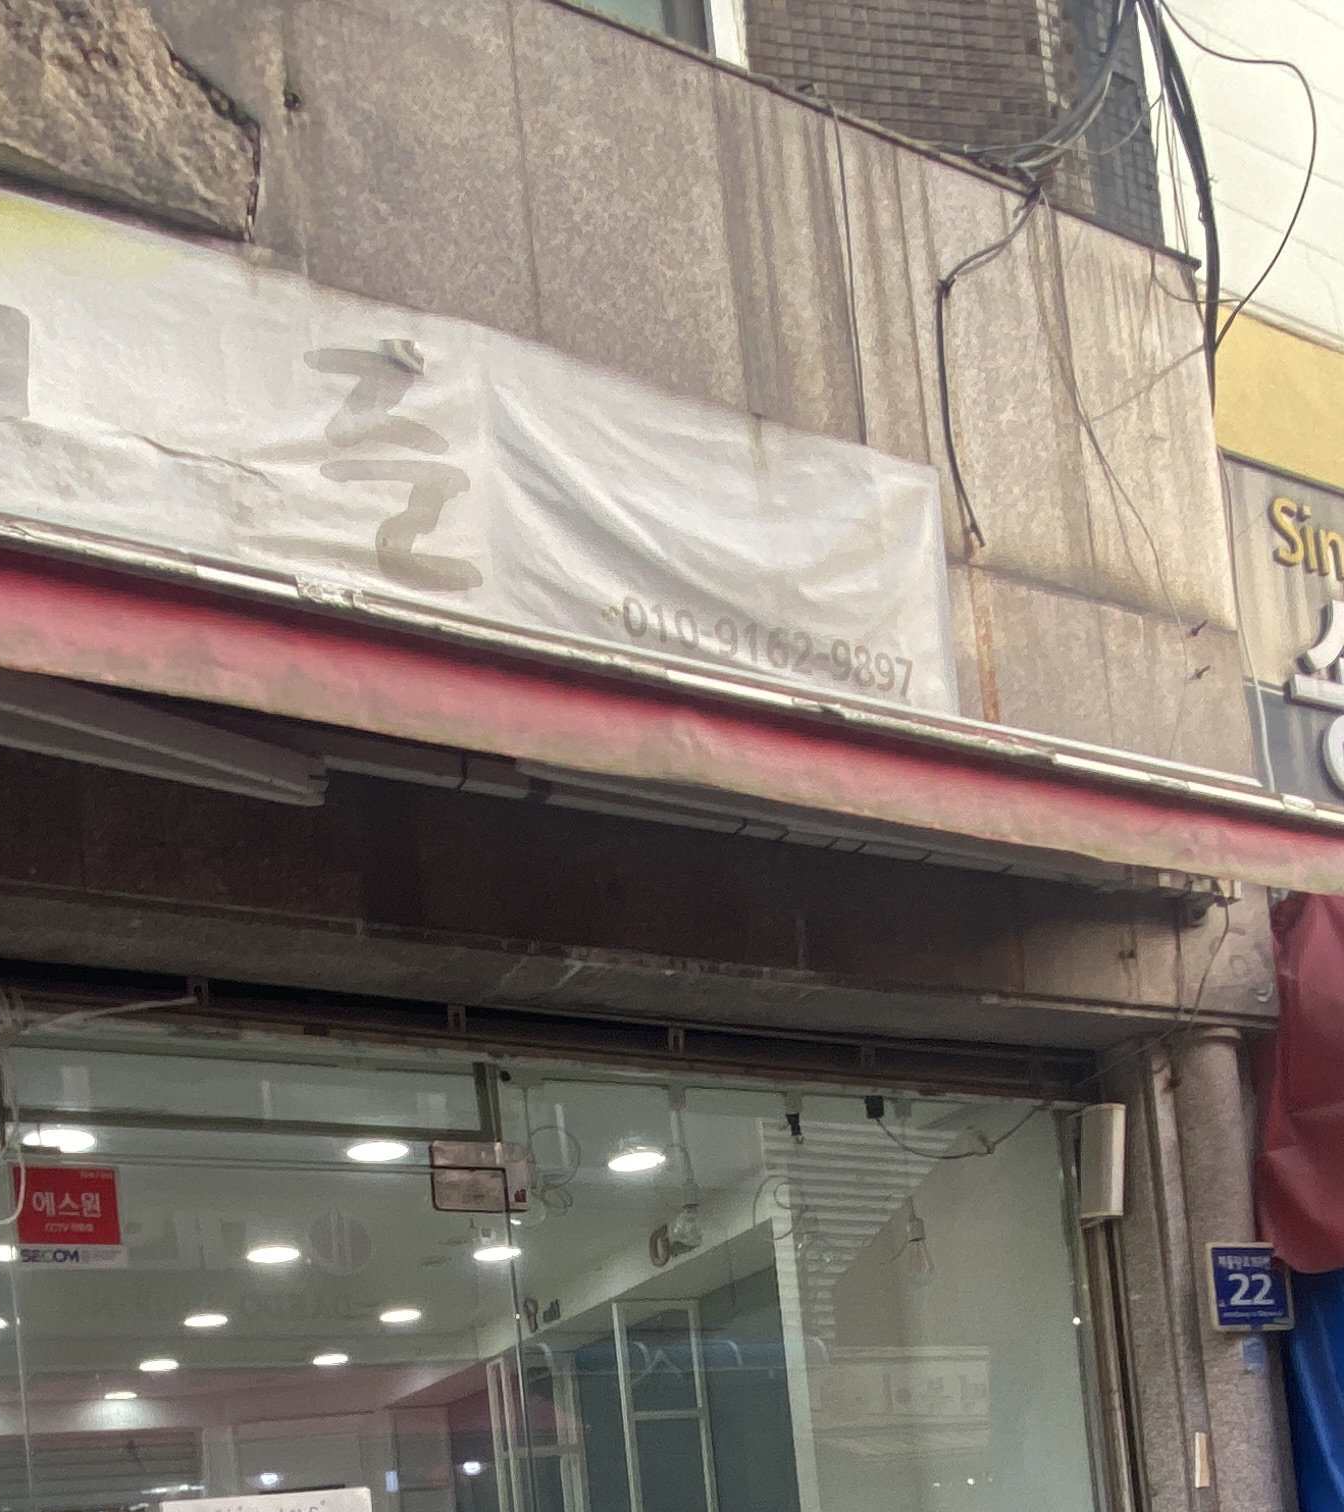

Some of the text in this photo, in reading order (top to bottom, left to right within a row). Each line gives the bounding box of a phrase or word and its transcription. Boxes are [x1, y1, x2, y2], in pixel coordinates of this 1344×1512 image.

[622, 596, 913, 697] 010-9162-9897
[31, 1191, 102, 1218] 에스원
[1228, 1273, 1276, 1306] 22
